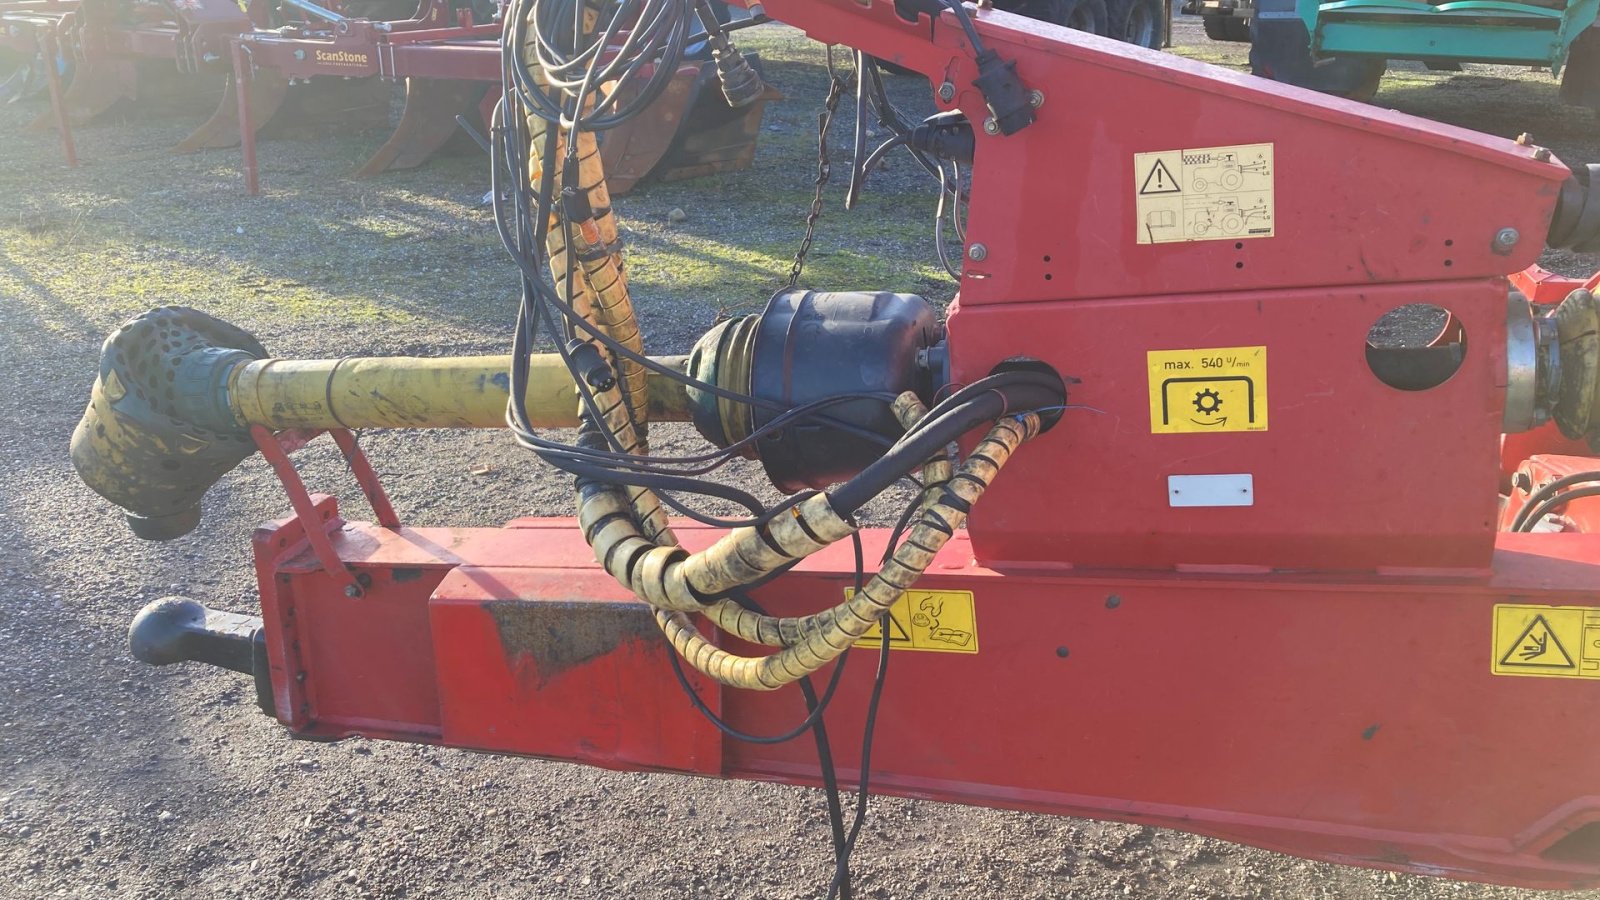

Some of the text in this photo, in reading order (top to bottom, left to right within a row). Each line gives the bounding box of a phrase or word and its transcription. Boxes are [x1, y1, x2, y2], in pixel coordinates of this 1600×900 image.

[315, 49, 368, 63] ScanStone
[1164, 360, 1194, 370] max.
[1201, 357, 1223, 368] 540
